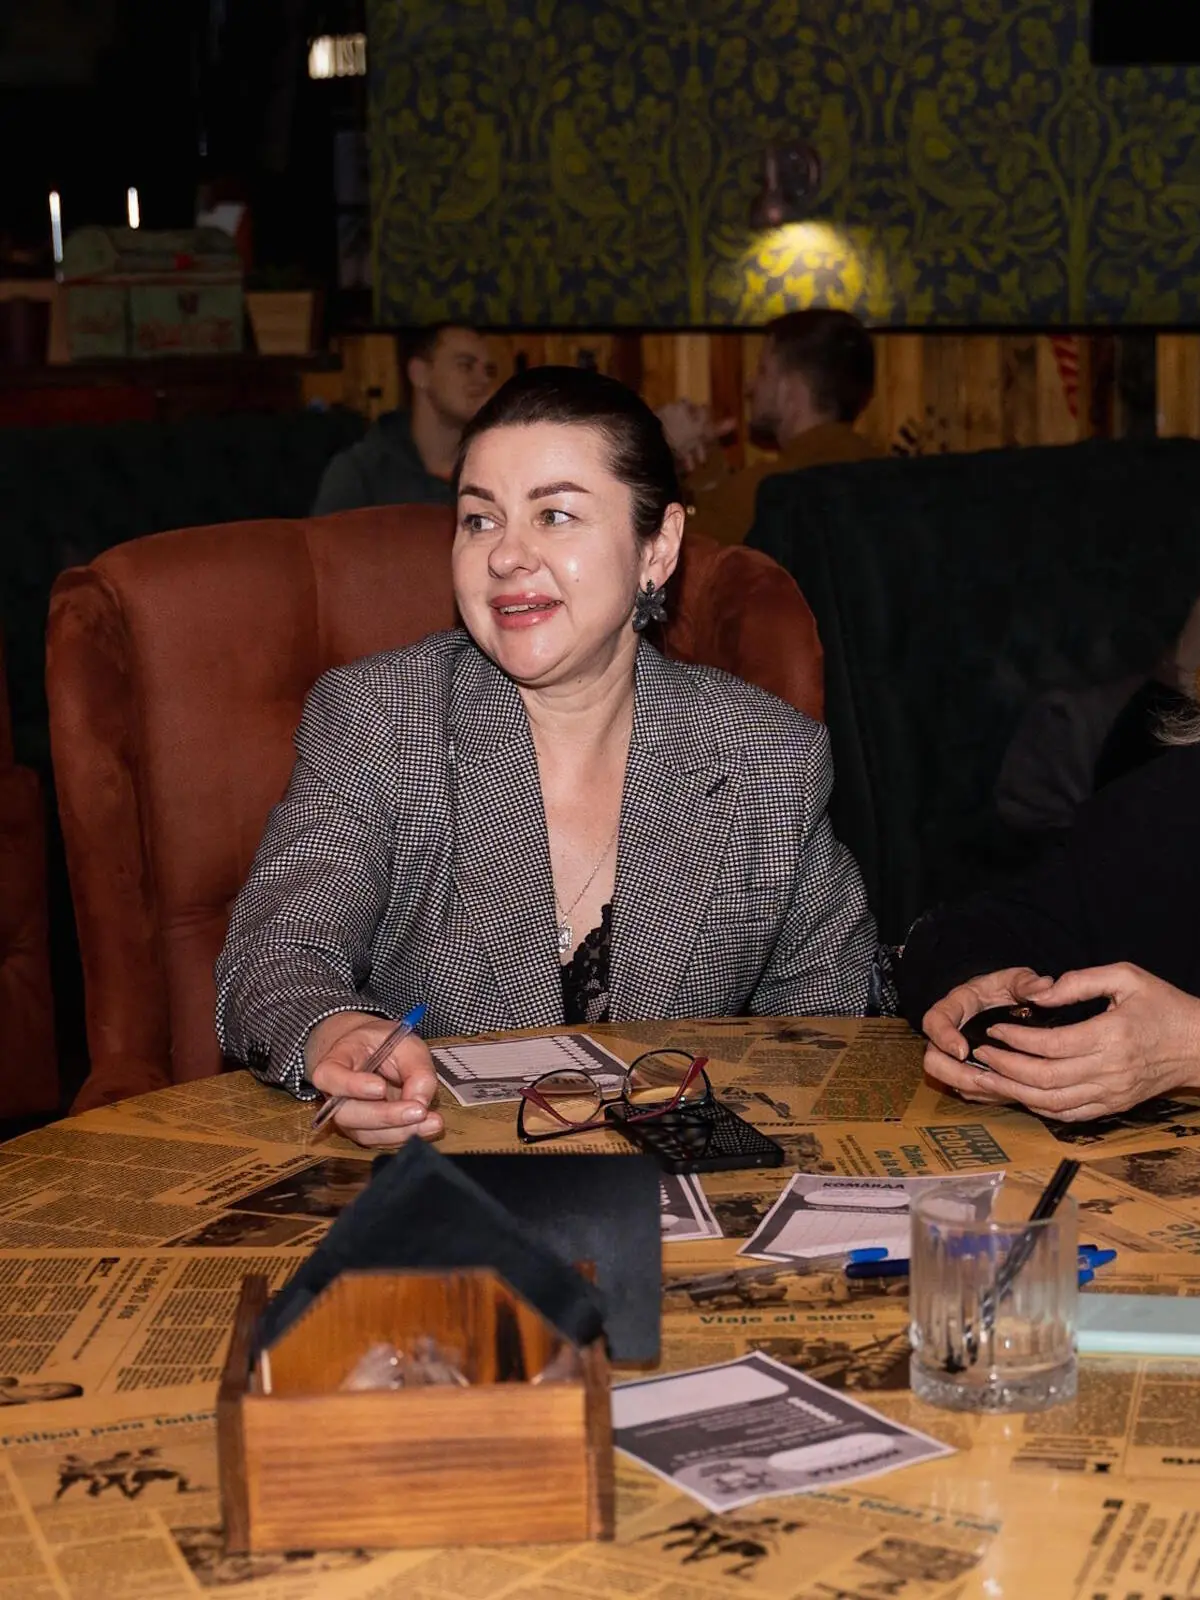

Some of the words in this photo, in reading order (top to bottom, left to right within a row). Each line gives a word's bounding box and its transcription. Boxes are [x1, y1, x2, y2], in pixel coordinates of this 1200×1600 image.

[699, 1314, 763, 1325] Viaje
[773, 1313, 797, 1323] al
[806, 1312, 875, 1321] surco
